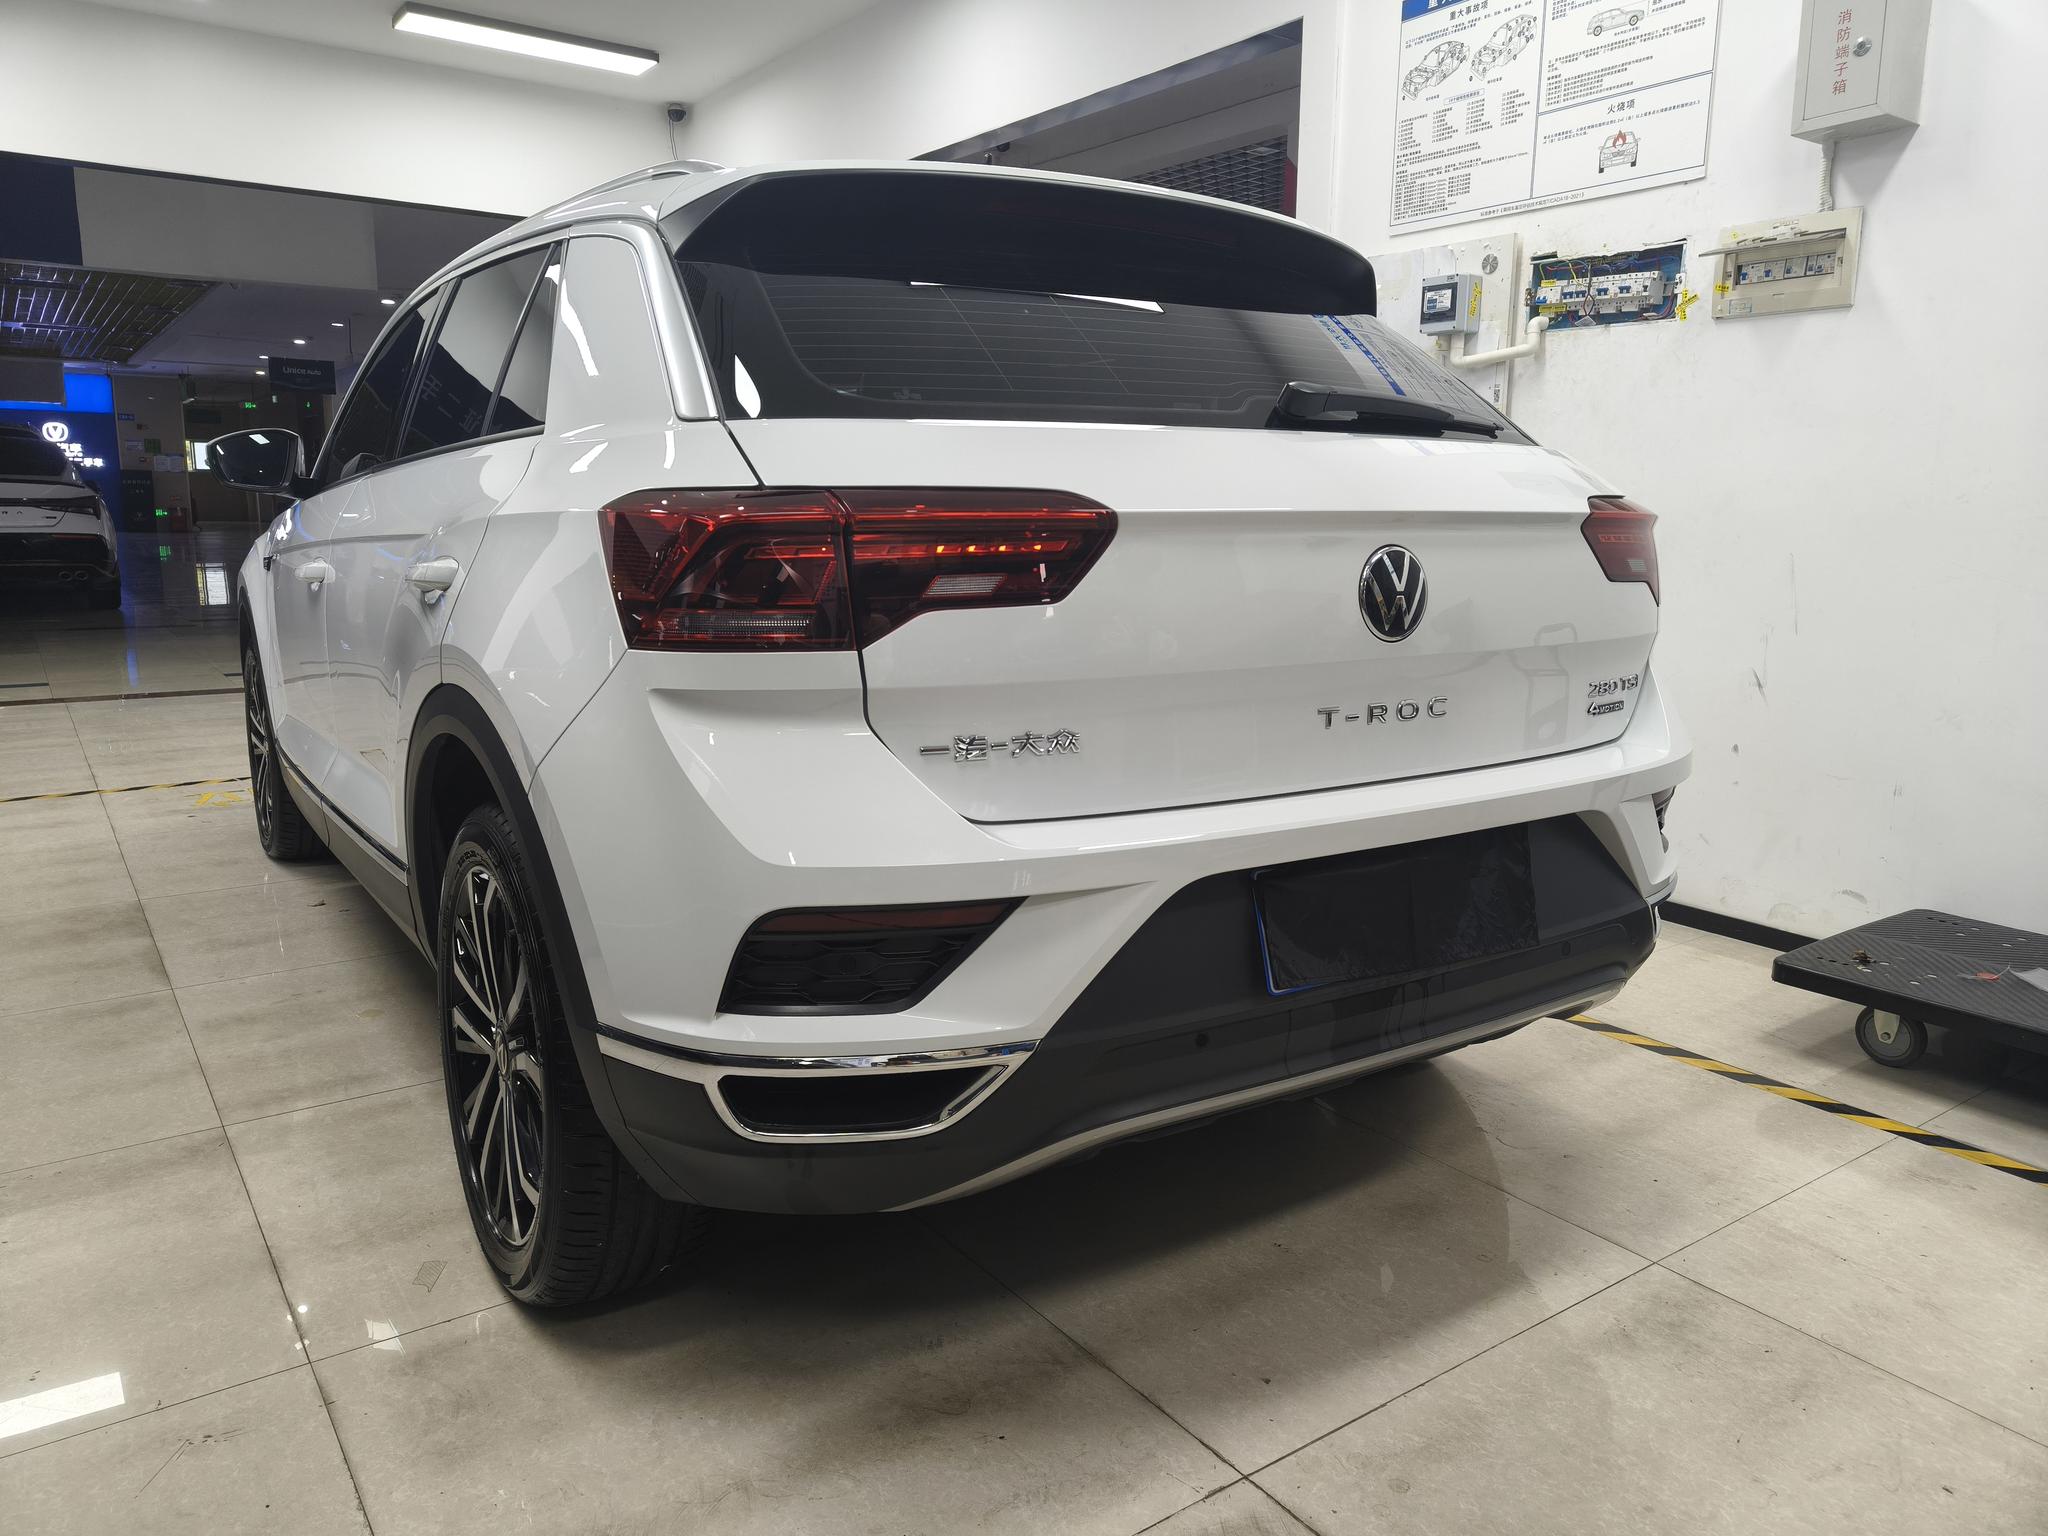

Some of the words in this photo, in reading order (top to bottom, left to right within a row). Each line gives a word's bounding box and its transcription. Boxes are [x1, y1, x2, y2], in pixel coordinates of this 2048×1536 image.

[1449, 0, 1489, 21] 重大事故项
[1832, 9, 1852, 95] 消防端子箱
[1607, 98, 1636, 115] 火烧项
[1588, 679, 1618, 698] 280
[1317, 695, 1449, 730] T-ROC
